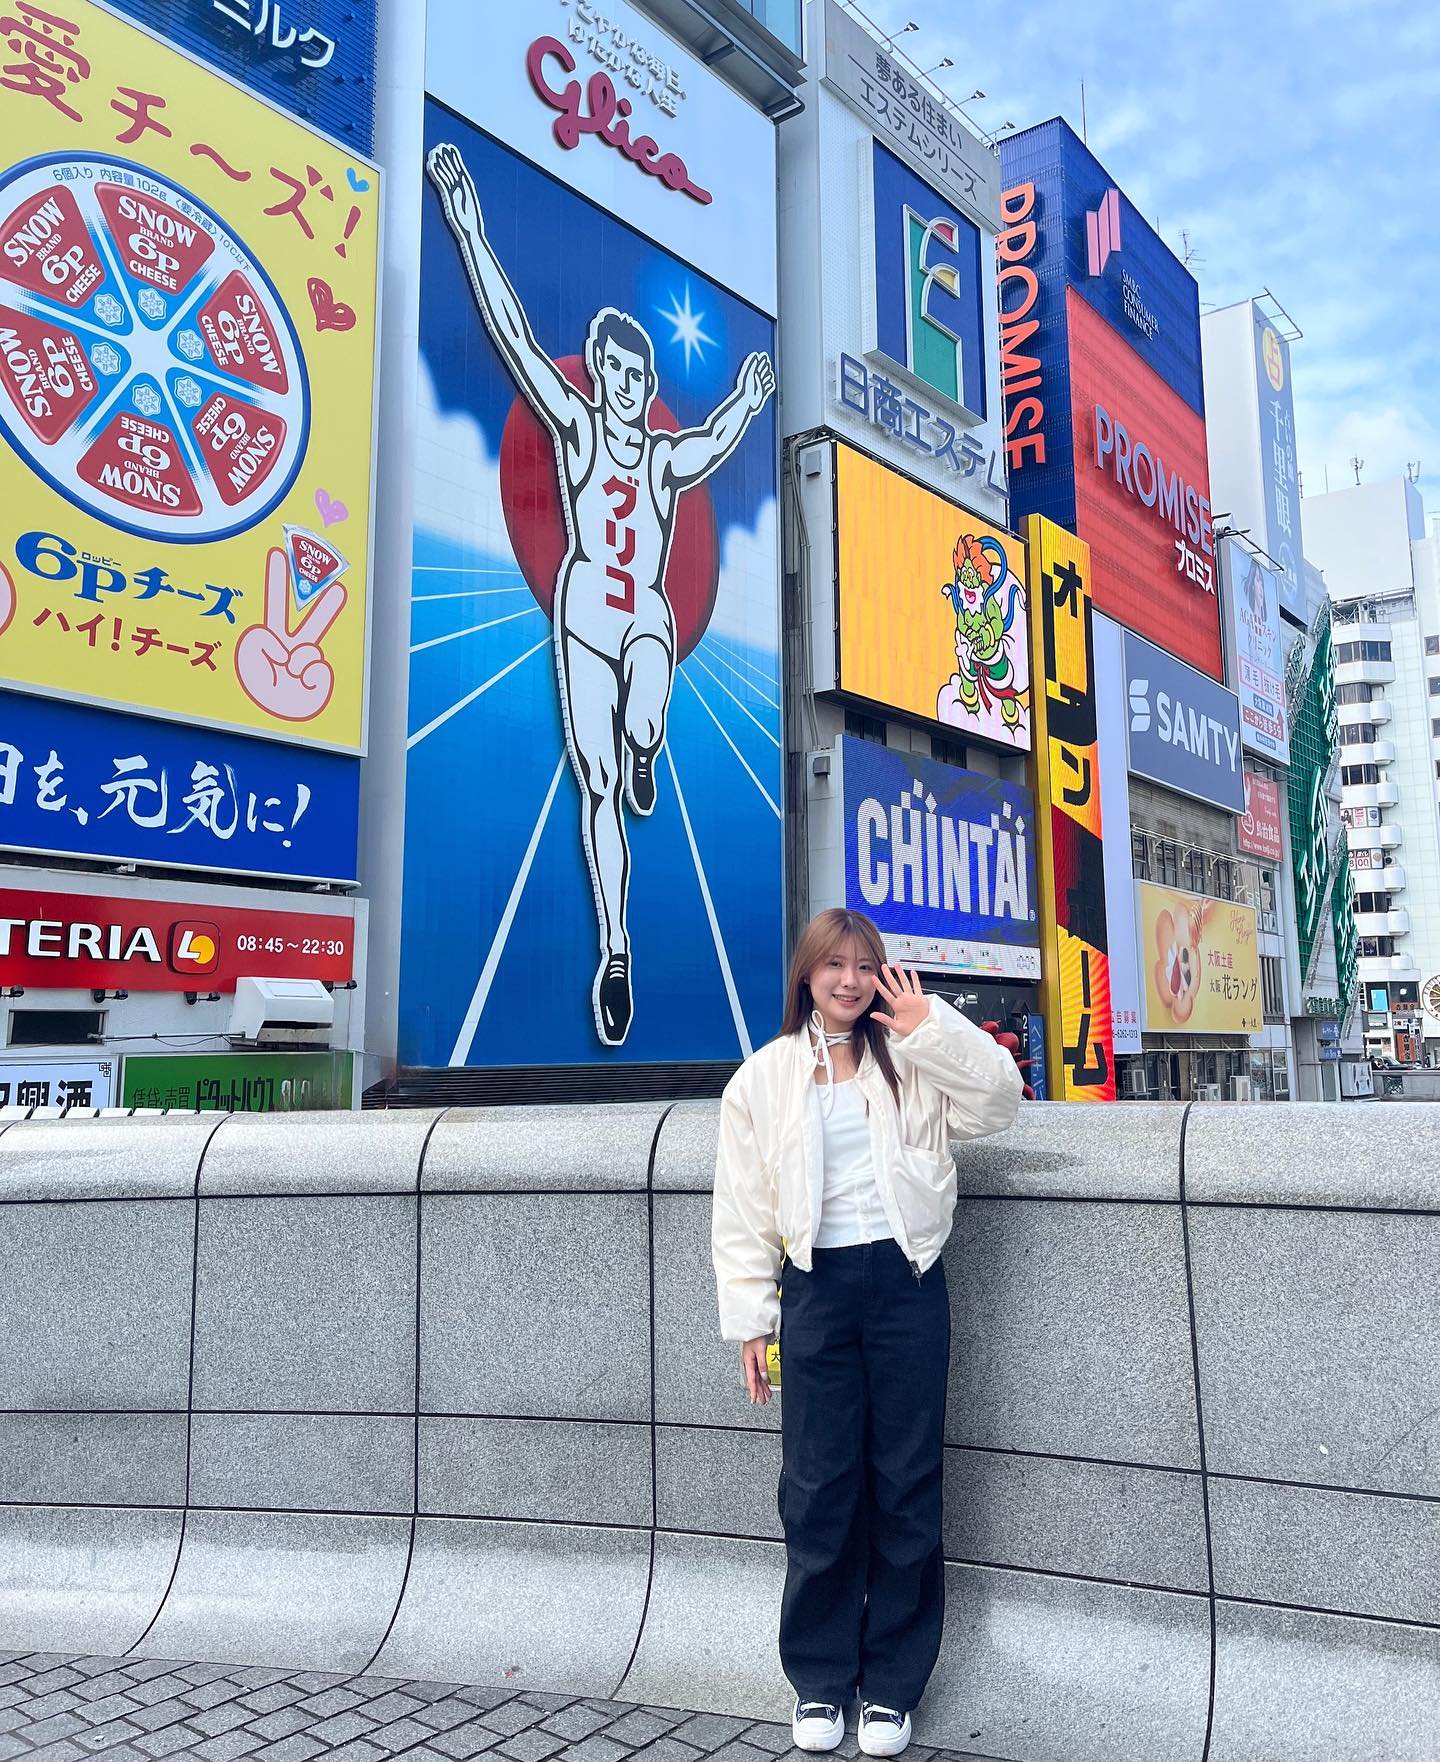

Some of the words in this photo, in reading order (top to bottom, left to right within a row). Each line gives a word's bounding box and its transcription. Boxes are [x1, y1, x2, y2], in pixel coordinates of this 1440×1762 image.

[527, 35, 713, 206] Glico
[875, 52, 962, 149] 夢ある住まい
[860, 77, 977, 202] エステムシリーズ
[3, 196, 66, 268] SNOW
[118, 195, 198, 248] SNOW
[138, 225, 175, 249] BRAND
[35, 233, 62, 262] BRAND
[42, 245, 86, 285] 6P
[128, 233, 180, 275] 6P
[65, 264, 102, 303] CHEESE
[129, 259, 178, 291] CHEESE
[1122, 268, 1142, 299] SMBC
[1123, 284, 1160, 335] CONSUMER
[1124, 299, 1153, 342] FINANCE
[201, 315, 229, 367] CHEESE
[217, 310, 245, 365] 6P
[234, 294, 282, 375] SNOW
[236, 318, 256, 355] BRAND
[0, 327, 53, 418] SNOW
[28, 348, 51, 390] BRAND
[42, 337, 75, 398] 6P
[62, 336, 94, 392] CHEESE
[121, 415, 170, 444] CHEESE
[195, 396, 227, 437] CHEESE
[210, 412, 247, 451] 6P
[840, 352, 1010, 500] 日商エステム
[117, 432, 171, 471] 6P
[227, 425, 276, 494] SNOW
[229, 432, 251, 461] BRAND
[98, 463, 181, 507] SNOW
[123, 460, 161, 479] BRAND
[1095, 403, 1214, 557] PROMISE
[298, 540, 332, 565] SNOW
[601, 474, 640, 615] グリコ
[1174, 538, 1216, 596] プロミス
[1156, 691, 1238, 772] SAMTY
[857, 779, 1028, 921] CHINTAI
[1208, 949, 1234, 969] 大阪土産
[1222, 974, 1258, 1002] 花ラング
